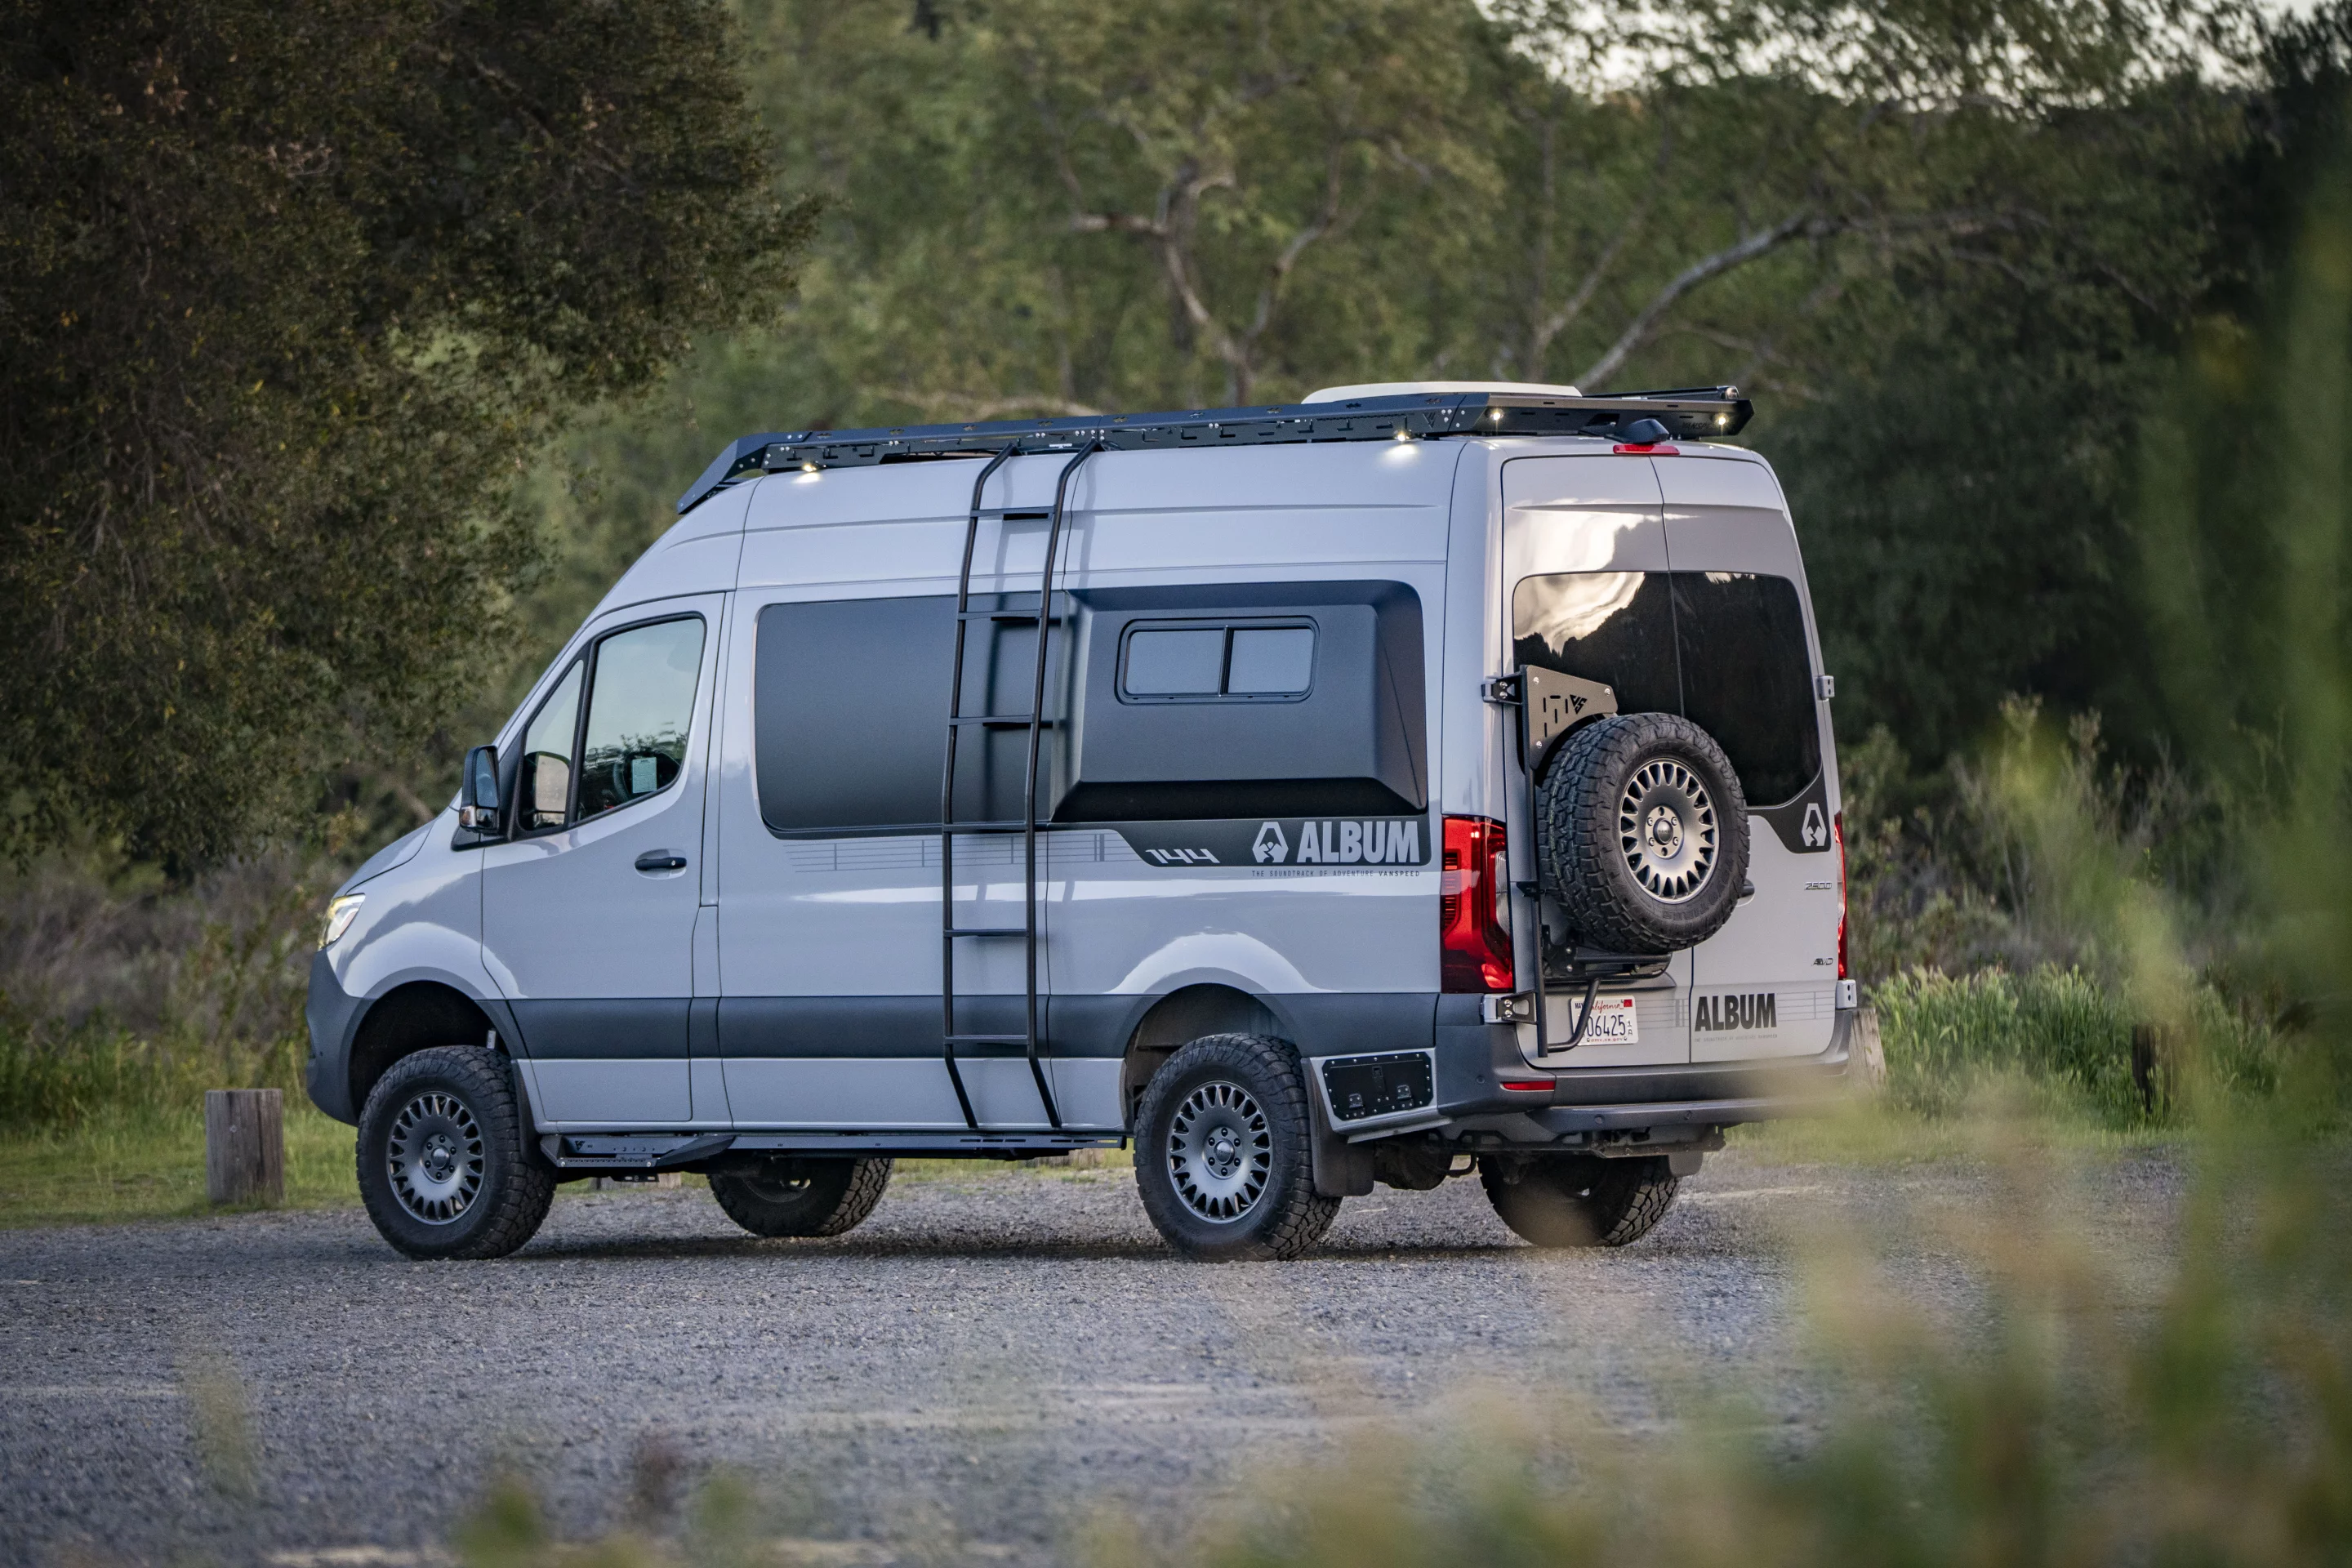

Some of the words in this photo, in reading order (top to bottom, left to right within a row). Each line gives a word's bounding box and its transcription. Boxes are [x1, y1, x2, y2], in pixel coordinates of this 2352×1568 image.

[1297, 821, 1420, 863] ALBUM
[1145, 849, 1220, 863] 144
[1804, 881, 1833, 890] 2500
[1695, 993, 1777, 1031] ALBUM
